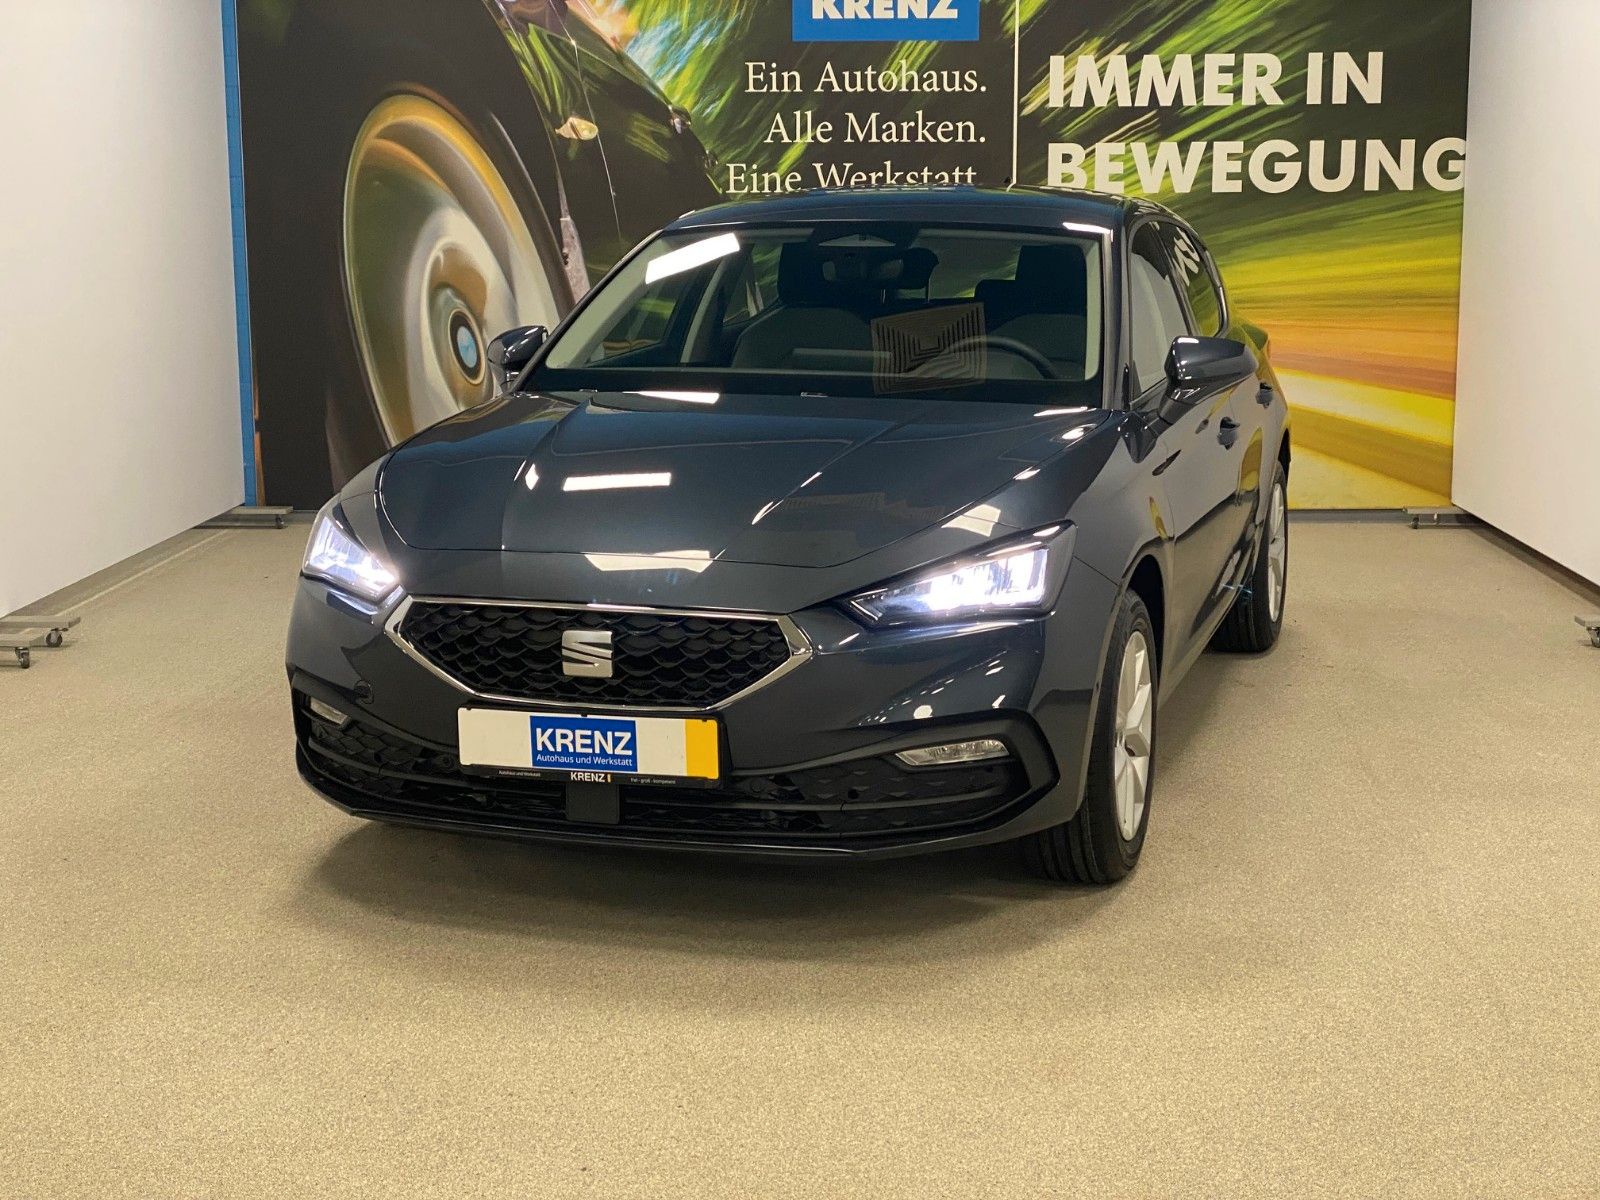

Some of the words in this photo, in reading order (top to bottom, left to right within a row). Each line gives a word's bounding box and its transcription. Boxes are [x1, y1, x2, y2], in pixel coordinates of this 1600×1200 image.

[811, 0, 958, 19] KRENZ
[744, 61, 802, 93] Ein
[814, 60, 987, 93] Autohaus.
[1048, 53, 1284, 108] IMMER
[1306, 51, 1384, 105] IN
[763, 110, 833, 143] Alle
[844, 110, 986, 143] Marken.
[726, 162, 802, 193] Eine
[1047, 137, 1466, 194] BEWEGUNG
[536, 727, 633, 756] KRENZ
[536, 753, 574, 764] Autohaus
[575, 756, 592, 764] und
[592, 757, 633, 767] Werkstatt
[570, 771, 606, 782] KRENZ
